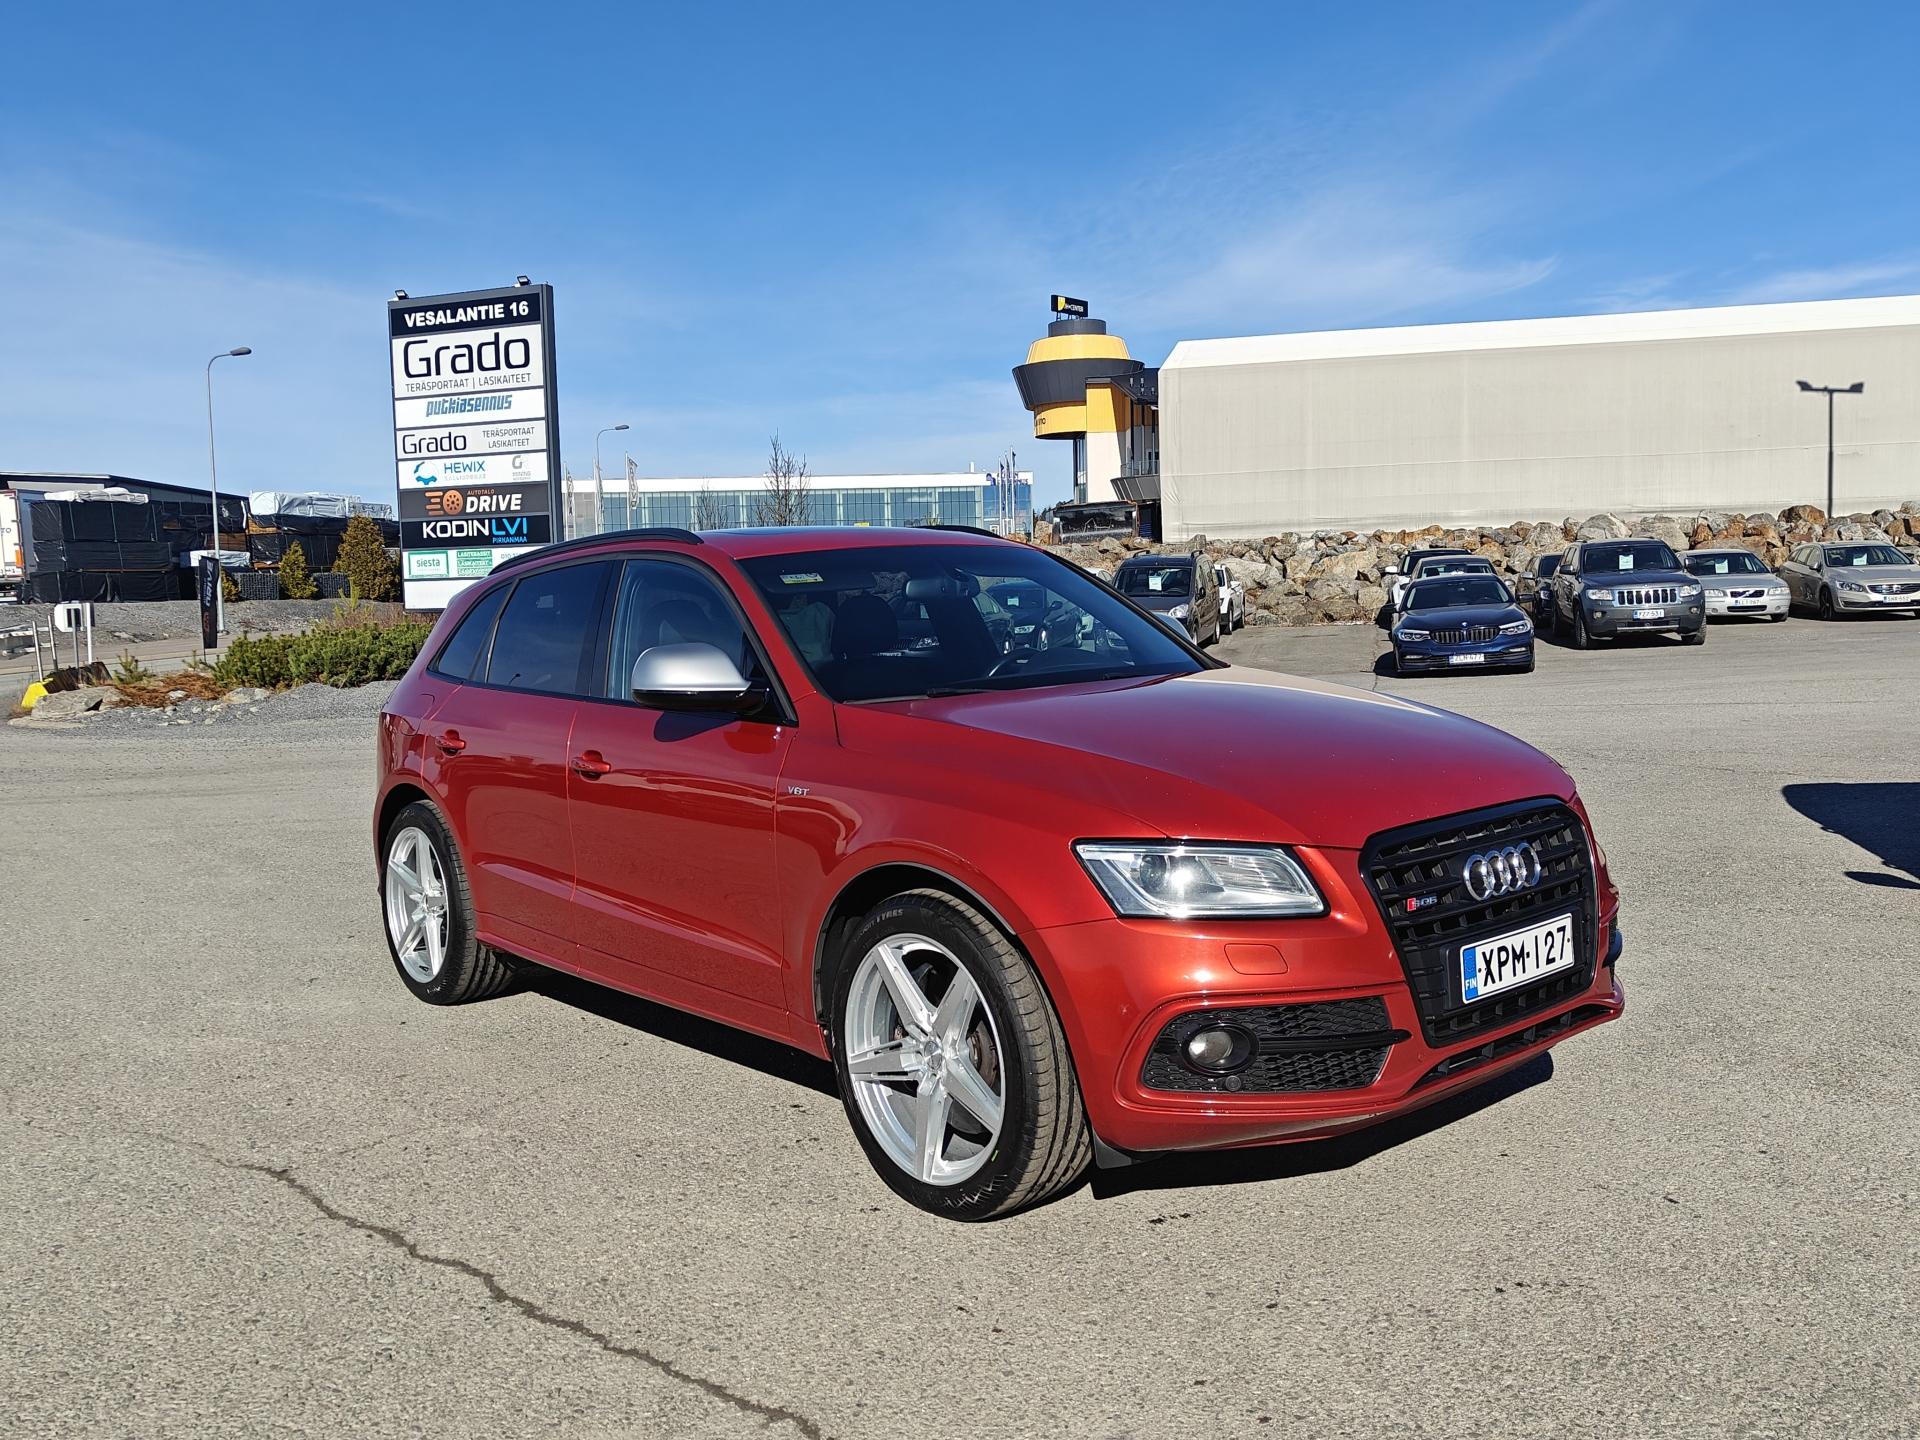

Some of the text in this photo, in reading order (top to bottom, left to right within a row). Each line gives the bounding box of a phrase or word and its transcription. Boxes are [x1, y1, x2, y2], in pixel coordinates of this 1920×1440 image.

[404, 301, 529, 328] VESALANTIE 16
[403, 332, 531, 379] Grado
[479, 373, 531, 386] LASIKAITEET
[425, 394, 513, 417] putkiasennus
[482, 427, 535, 438] TERÄSPORTAAT
[402, 431, 467, 455] Grado
[488, 438, 530, 449] LASIKAITEET
[443, 460, 486, 474] HEWIX
[465, 493, 522, 513] DRIVE
[492, 536, 528, 544] PIRKANMAA
[416, 558, 441, 568] siesta
[1482, 925, 1567, 988] XPM-127
[1465, 978, 1478, 990] FIN
